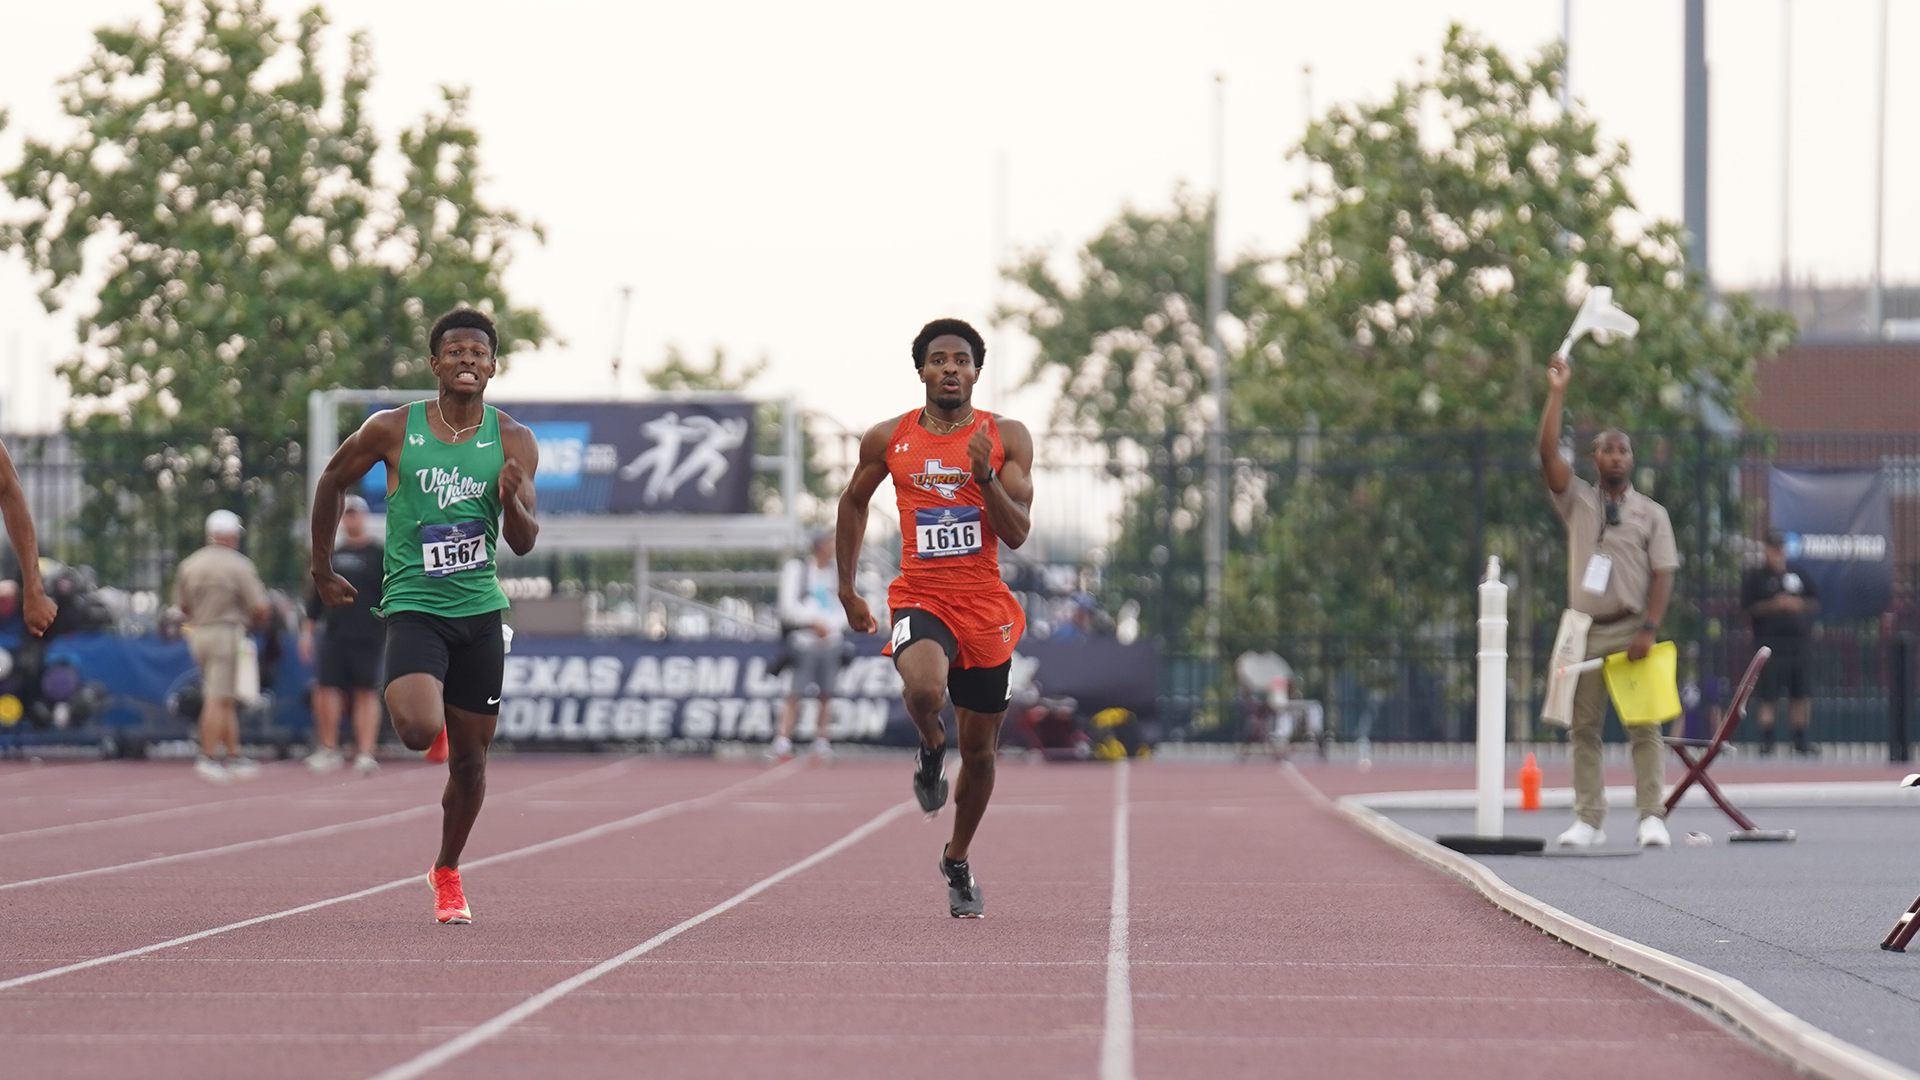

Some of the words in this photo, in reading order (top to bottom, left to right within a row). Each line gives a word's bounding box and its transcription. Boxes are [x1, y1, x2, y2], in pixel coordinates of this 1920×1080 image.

[415, 466, 460, 494] Utah
[433, 476, 487, 510] Valley
[914, 472, 971, 486] UTRGV
[925, 525, 975, 550] 1616
[430, 539, 481, 568] 1567
[894, 622, 905, 648] 2
[504, 656, 623, 697] EXAS
[500, 698, 678, 739] OLLEGE
